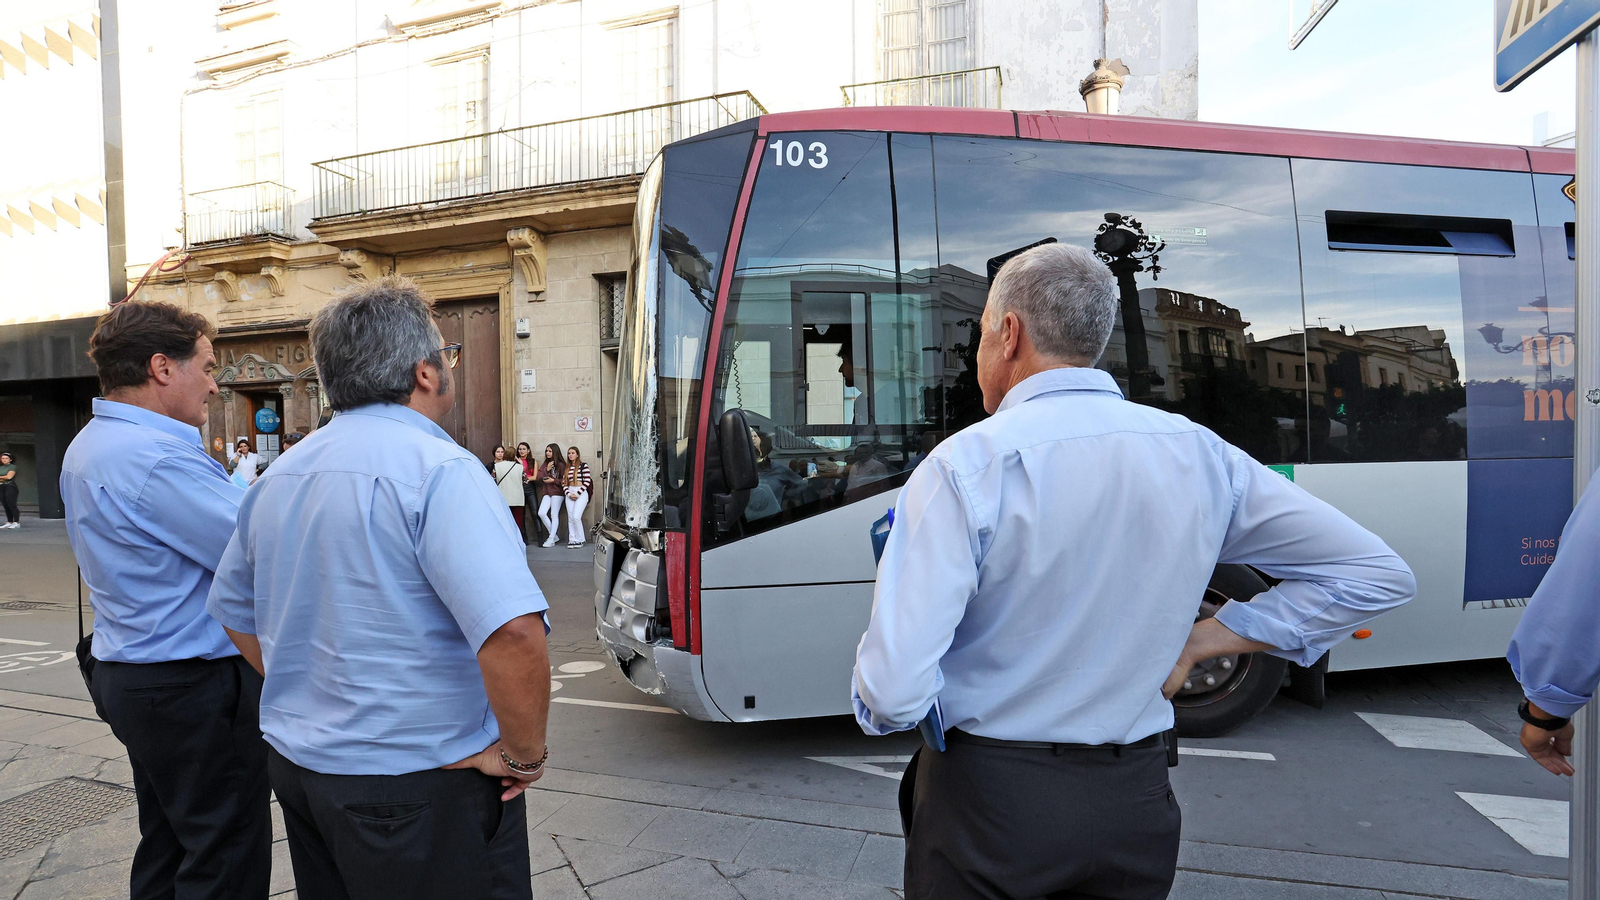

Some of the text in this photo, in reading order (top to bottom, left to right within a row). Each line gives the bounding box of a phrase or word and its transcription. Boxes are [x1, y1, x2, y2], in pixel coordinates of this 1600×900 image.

[769, 139, 829, 169] 103
[212, 348, 237, 369] IA
[1521, 537, 1532, 549] Si
[1535, 538, 1555, 549] nos
[1520, 553, 1556, 566] Cuide
